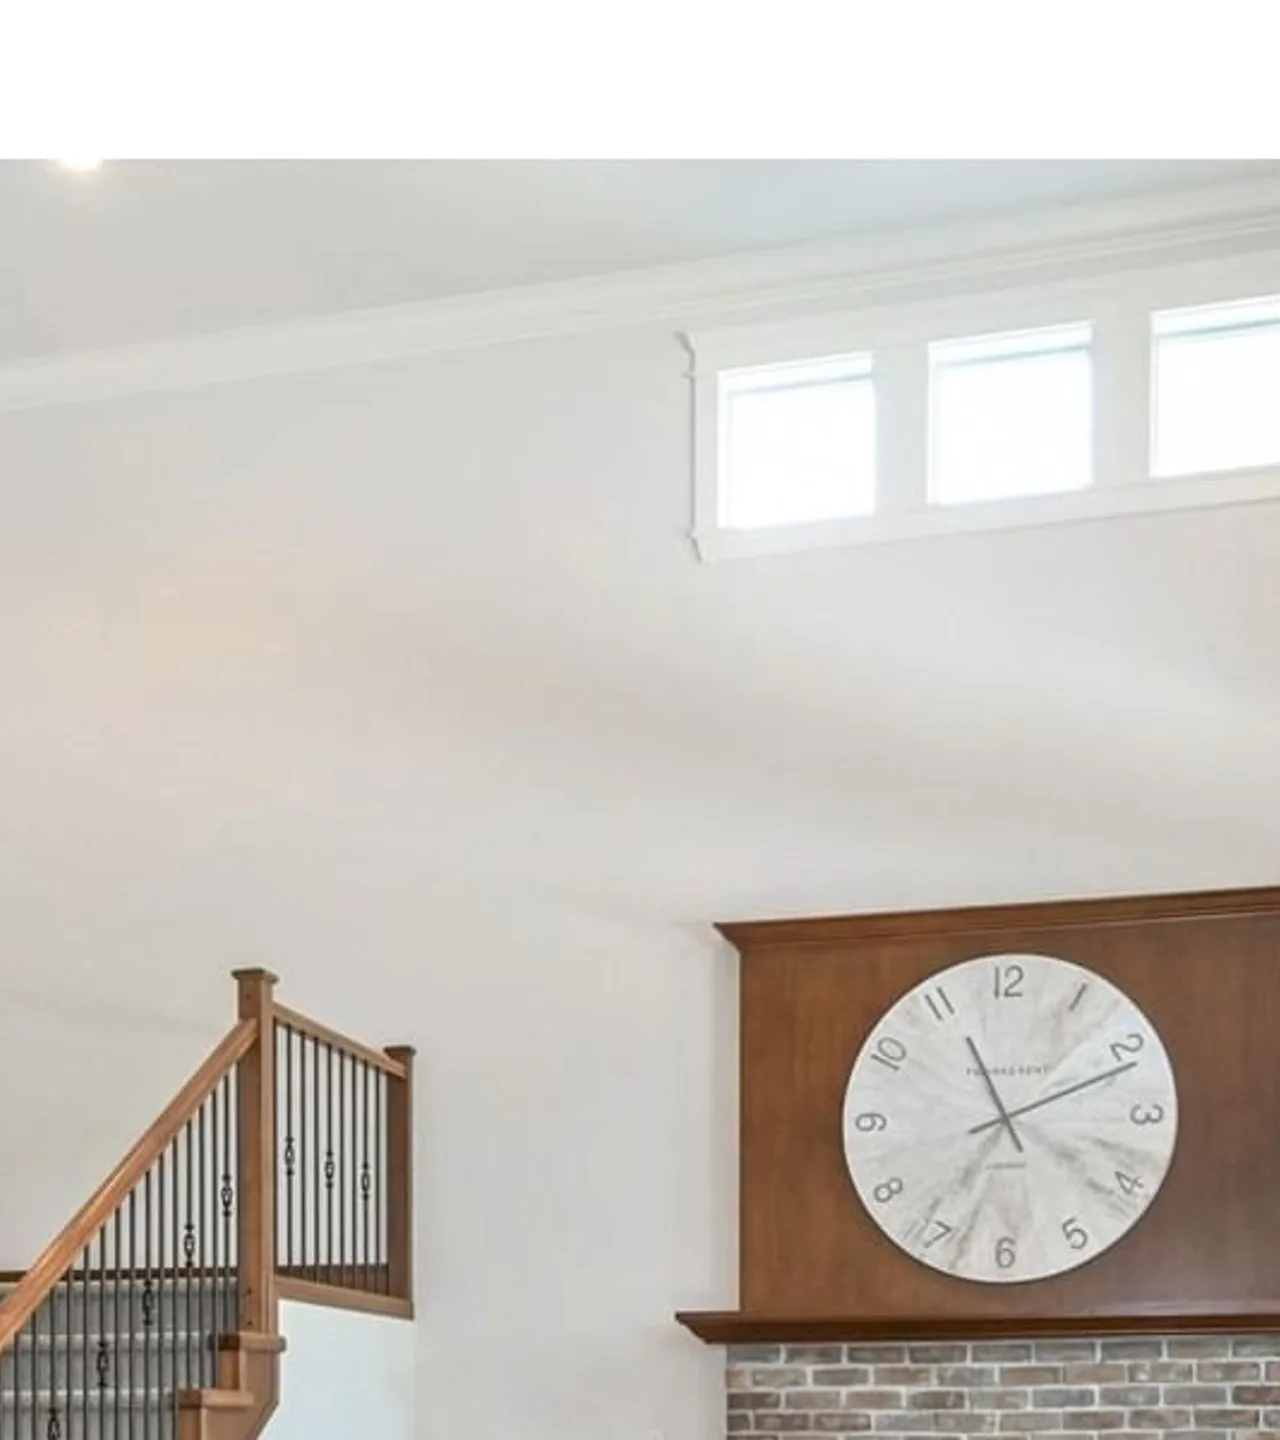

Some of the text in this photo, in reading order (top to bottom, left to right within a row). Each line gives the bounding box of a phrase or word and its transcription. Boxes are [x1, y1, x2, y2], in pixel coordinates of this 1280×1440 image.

[993, 965, 1025, 999] 12
[1069, 982, 1087, 1011] 1
[924, 986, 954, 1021] 11
[871, 1036, 908, 1072] 10
[1109, 1033, 1145, 1063] 2
[855, 1112, 887, 1132] 9
[1129, 1103, 1164, 1125] 3
[872, 1177, 904, 1204] 8
[1113, 1170, 1145, 1196] 4
[924, 1221, 952, 1249] 7
[1062, 1218, 1089, 1250] 5
[994, 1237, 1016, 1269] 6
